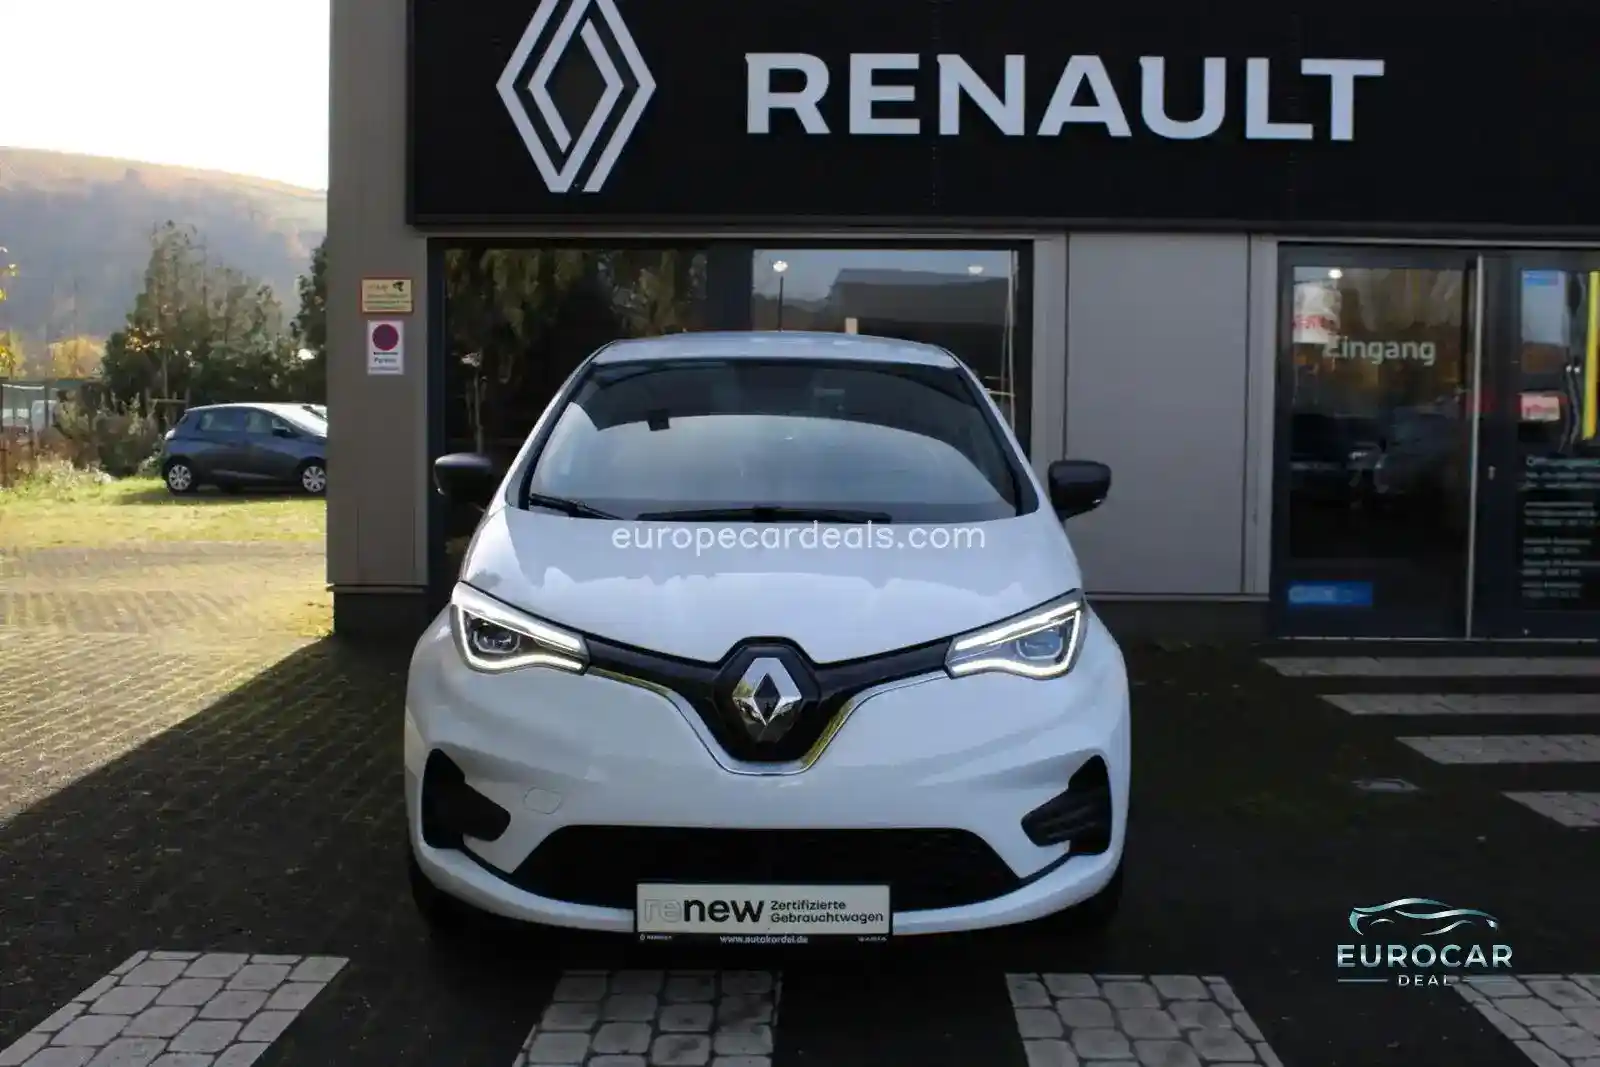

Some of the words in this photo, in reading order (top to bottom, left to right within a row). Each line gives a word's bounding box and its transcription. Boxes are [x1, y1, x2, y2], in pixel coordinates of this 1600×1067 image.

[745, 52, 1385, 141] RENAULT
[1322, 334, 1436, 366] Eingang
[644, 898, 765, 923] renew
[770, 900, 847, 911] Zertifizierte
[770, 912, 884, 925] Gebrauchtwagen
